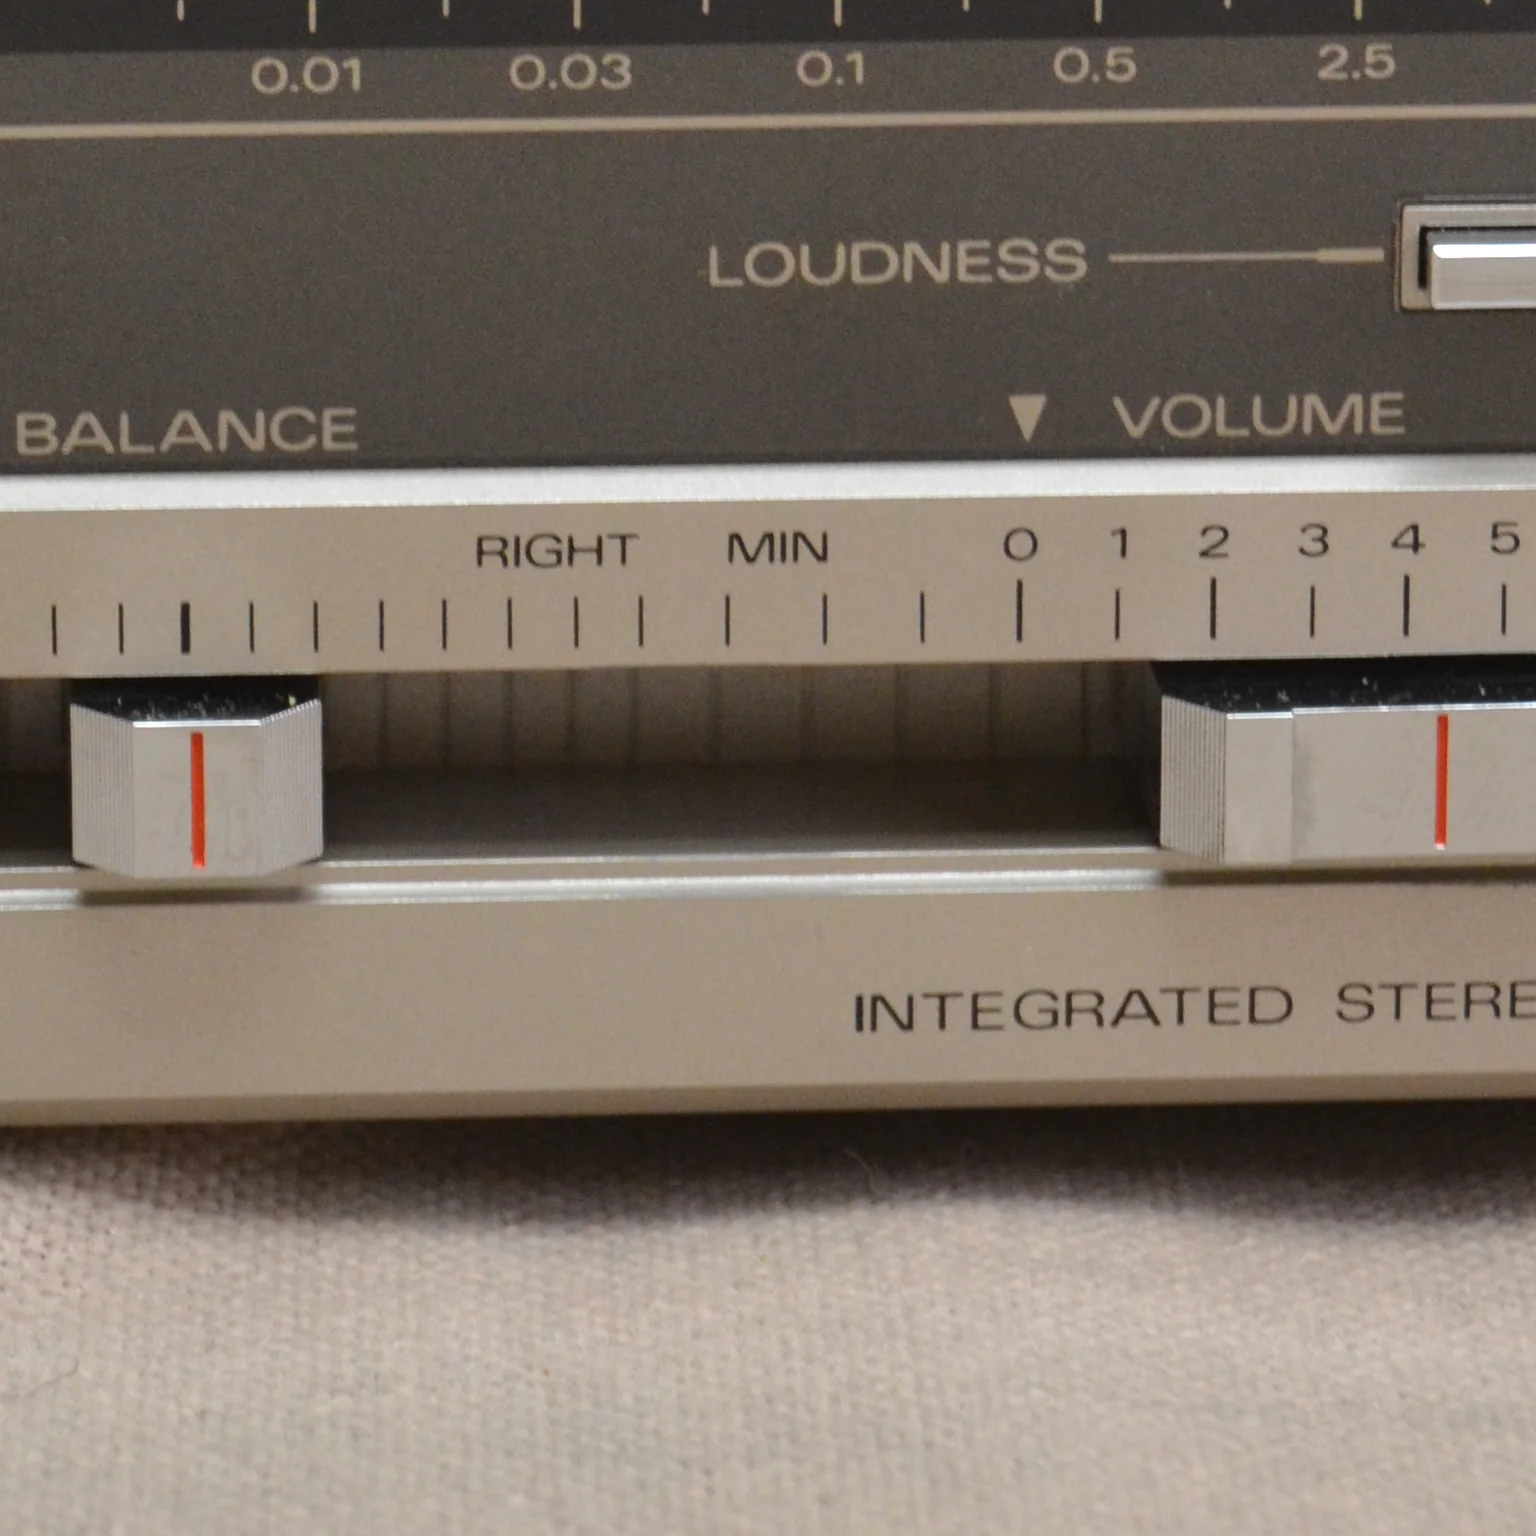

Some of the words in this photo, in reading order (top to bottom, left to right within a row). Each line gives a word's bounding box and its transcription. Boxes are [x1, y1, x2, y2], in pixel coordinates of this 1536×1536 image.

[251, 56, 361, 95] 0.01
[509, 52, 632, 91] 0.03
[796, 50, 864, 87] 0.1
[1053, 46, 1137, 83] 0.5
[1317, 43, 1396, 80] 2.5
[709, 238, 1088, 287] LOUDNESS
[16, 406, 358, 455] BALANCE
[1113, 391, 1405, 438] VOLUME
[476, 533, 639, 568] RIGHT
[728, 531, 829, 564] MIN
[1003, 527, 1039, 562] 0
[1110, 527, 1128, 559] 1
[1198, 525, 1230, 559] 2
[1298, 523, 1330, 558] 3
[1391, 523, 1425, 555] 4
[1489, 521, 1521, 555] 5
[855, 986, 1294, 1033] INTEGRATED
